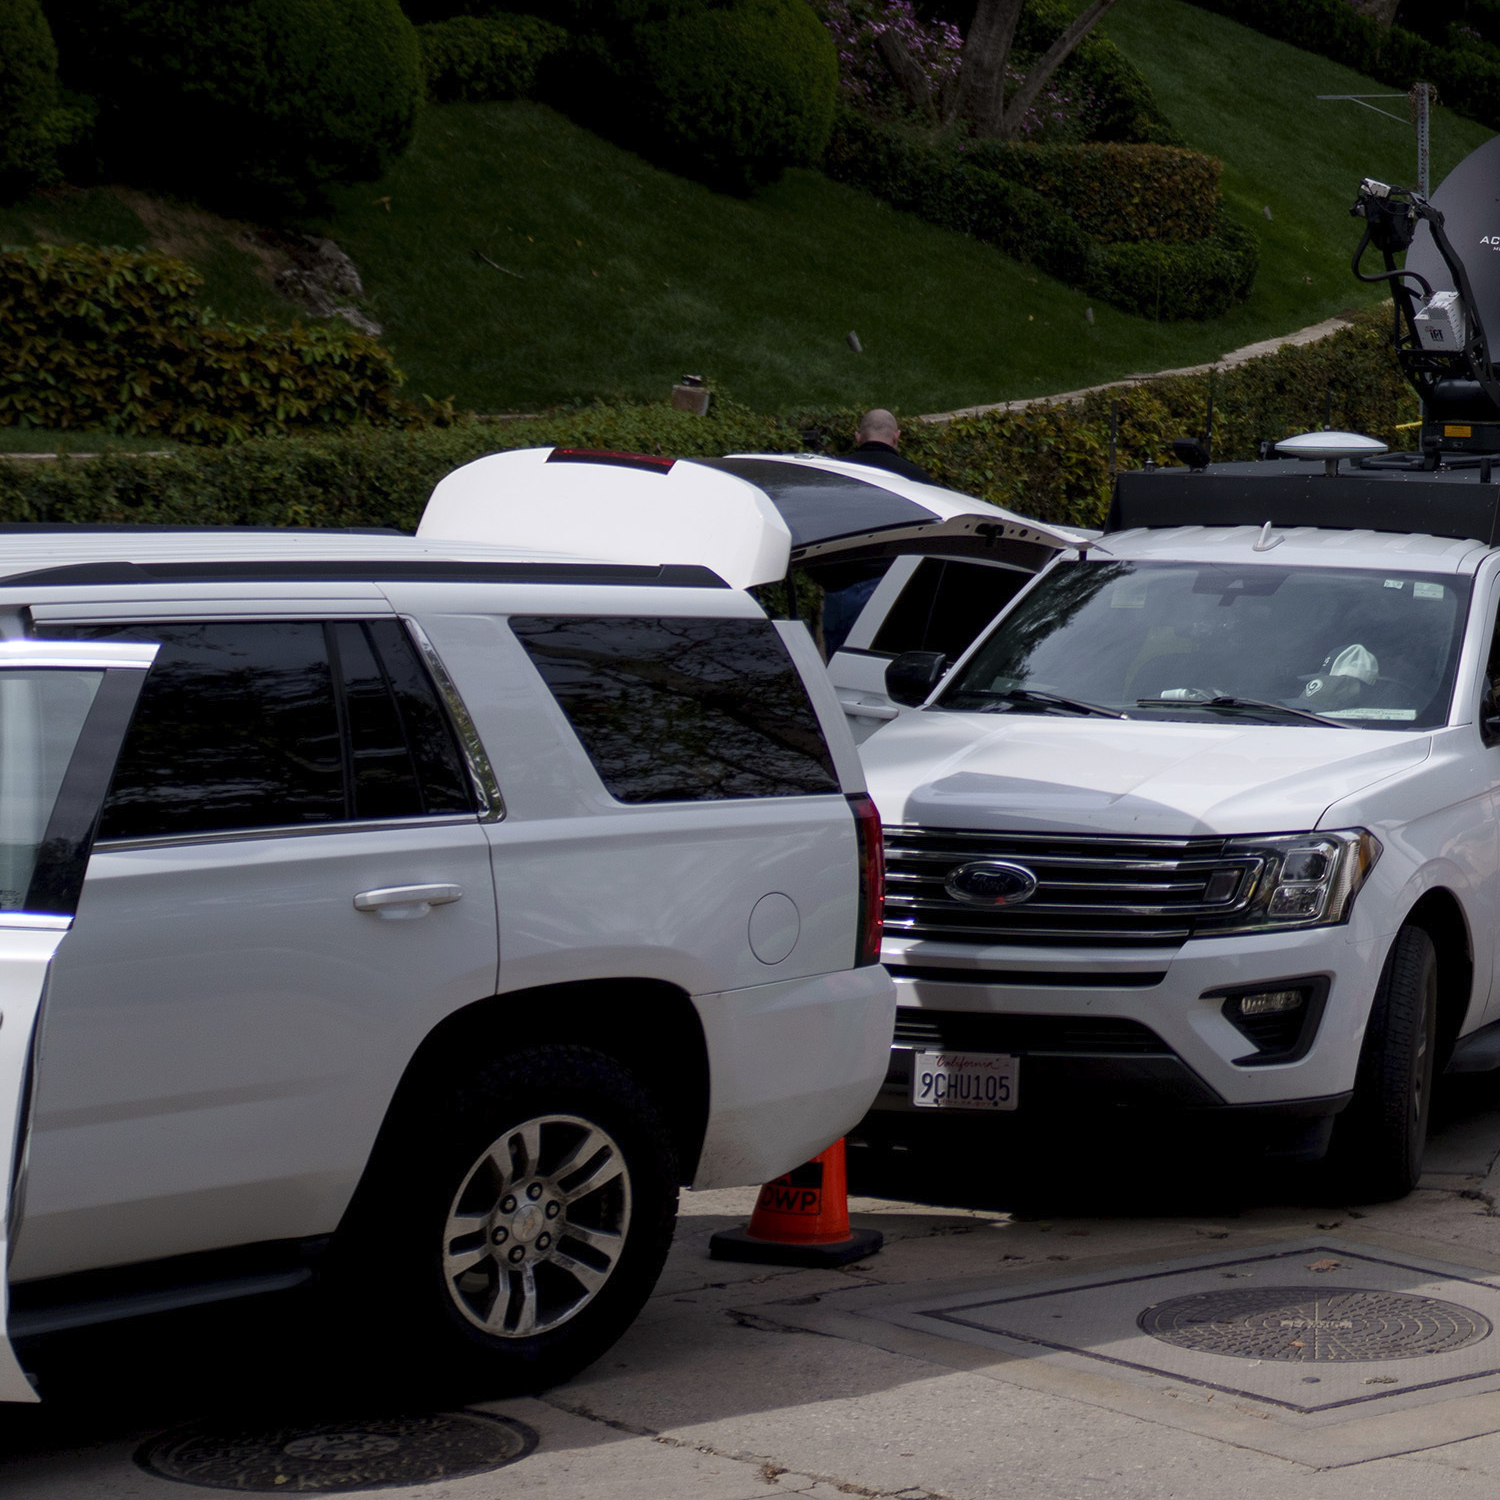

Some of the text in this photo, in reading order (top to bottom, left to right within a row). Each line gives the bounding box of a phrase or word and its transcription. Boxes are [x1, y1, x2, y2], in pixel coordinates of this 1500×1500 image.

[937, 1054, 1000, 1071] California
[920, 1072, 1010, 1102] 9CHU105
[762, 1186, 817, 1211] DWP
